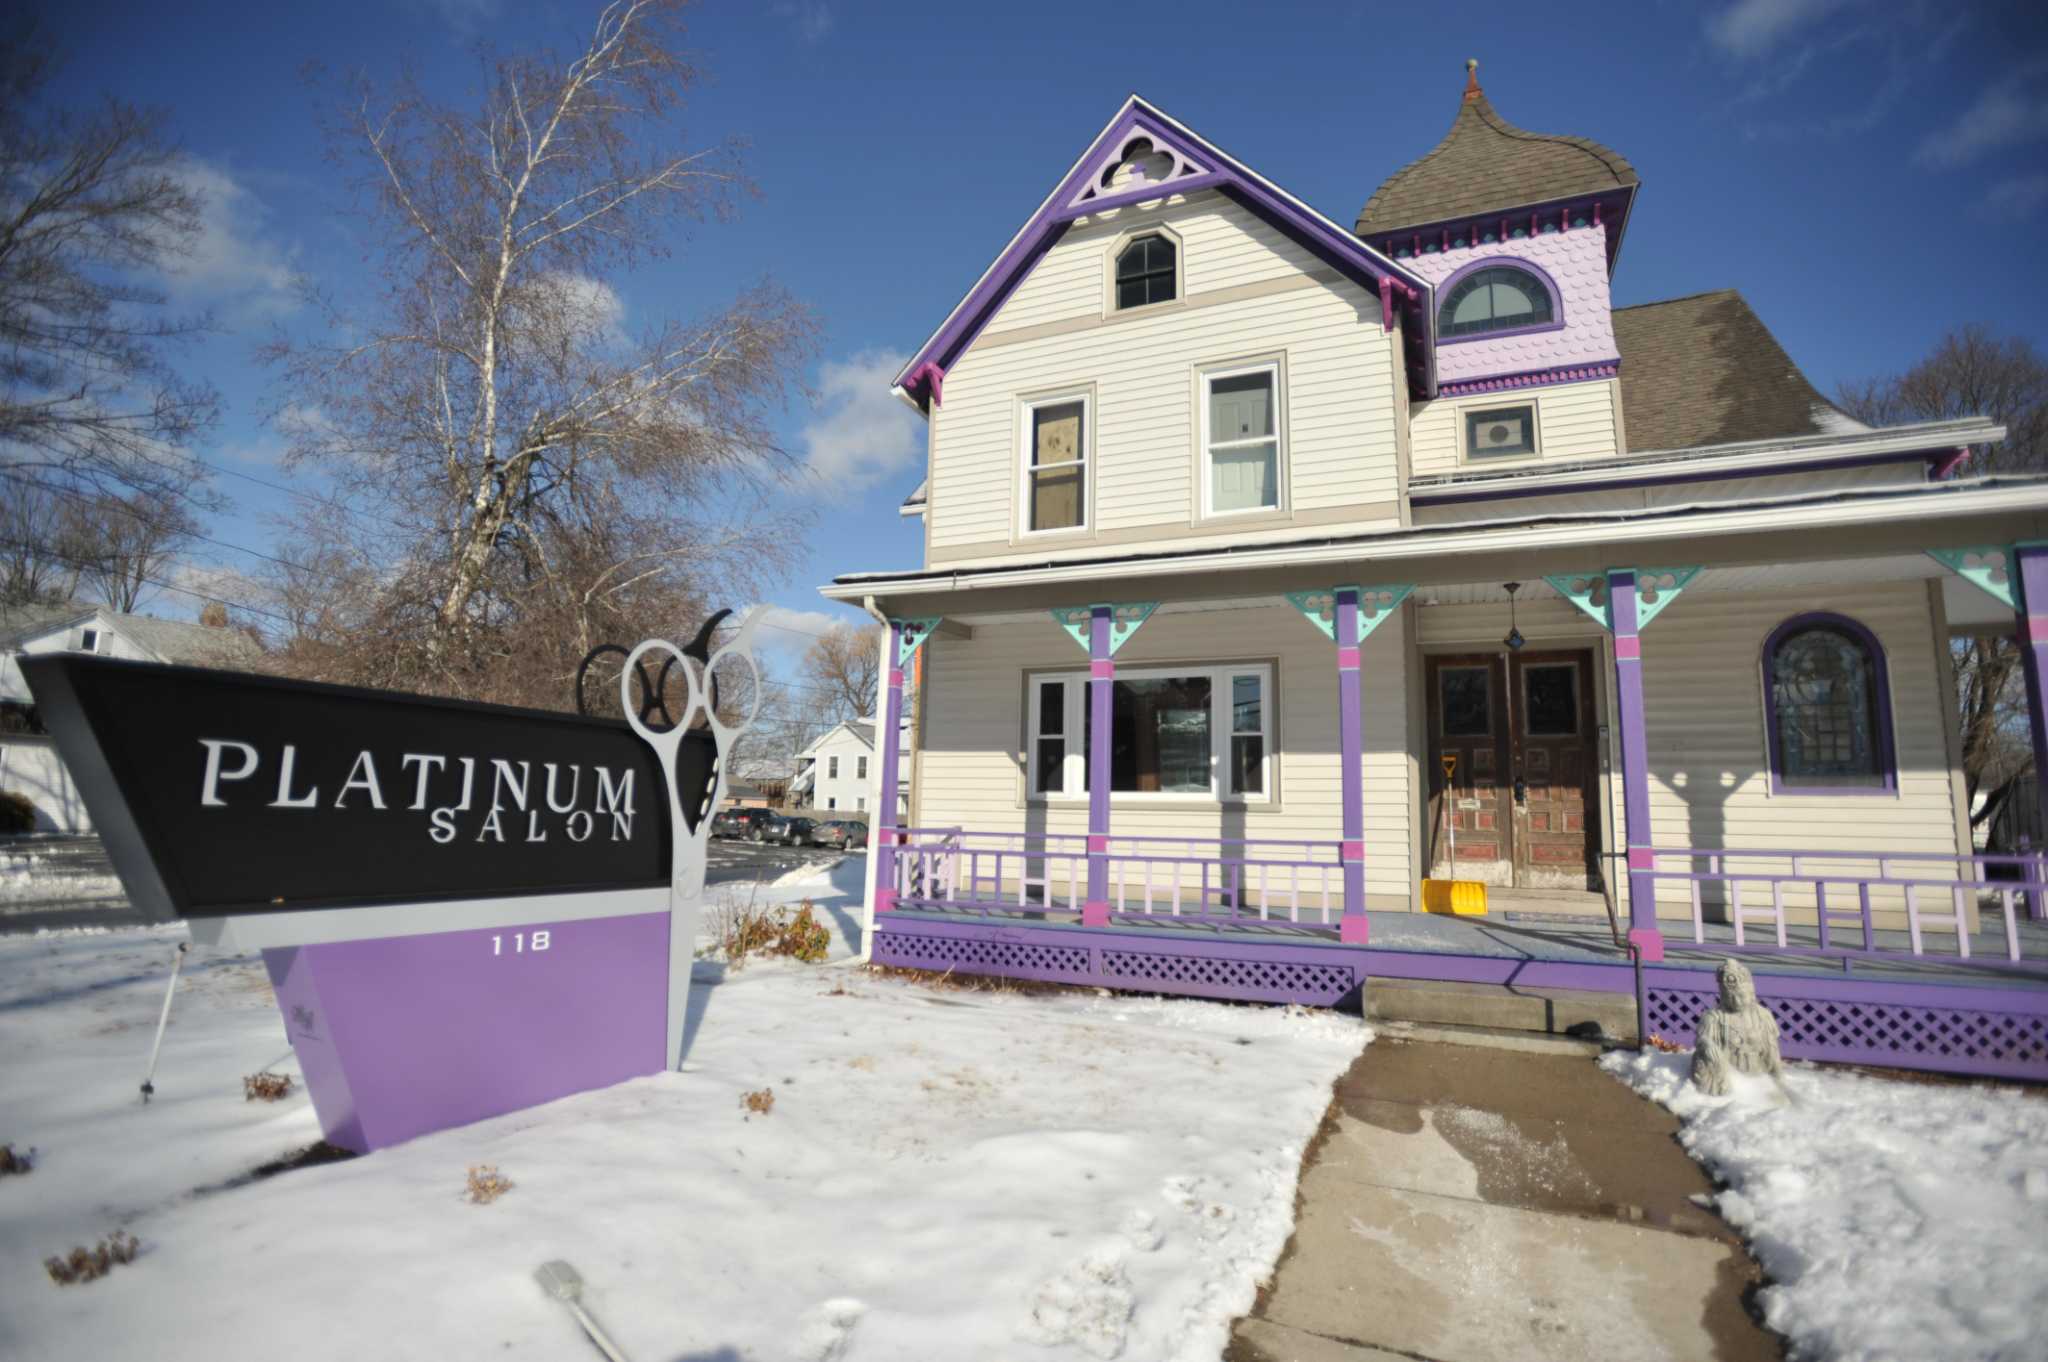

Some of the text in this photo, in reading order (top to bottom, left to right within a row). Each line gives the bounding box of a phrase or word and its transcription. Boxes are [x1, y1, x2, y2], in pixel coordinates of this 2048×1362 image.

[199, 739, 636, 814] PLATINUM
[429, 807, 633, 843] SALON
[492, 931, 551, 955] 118
